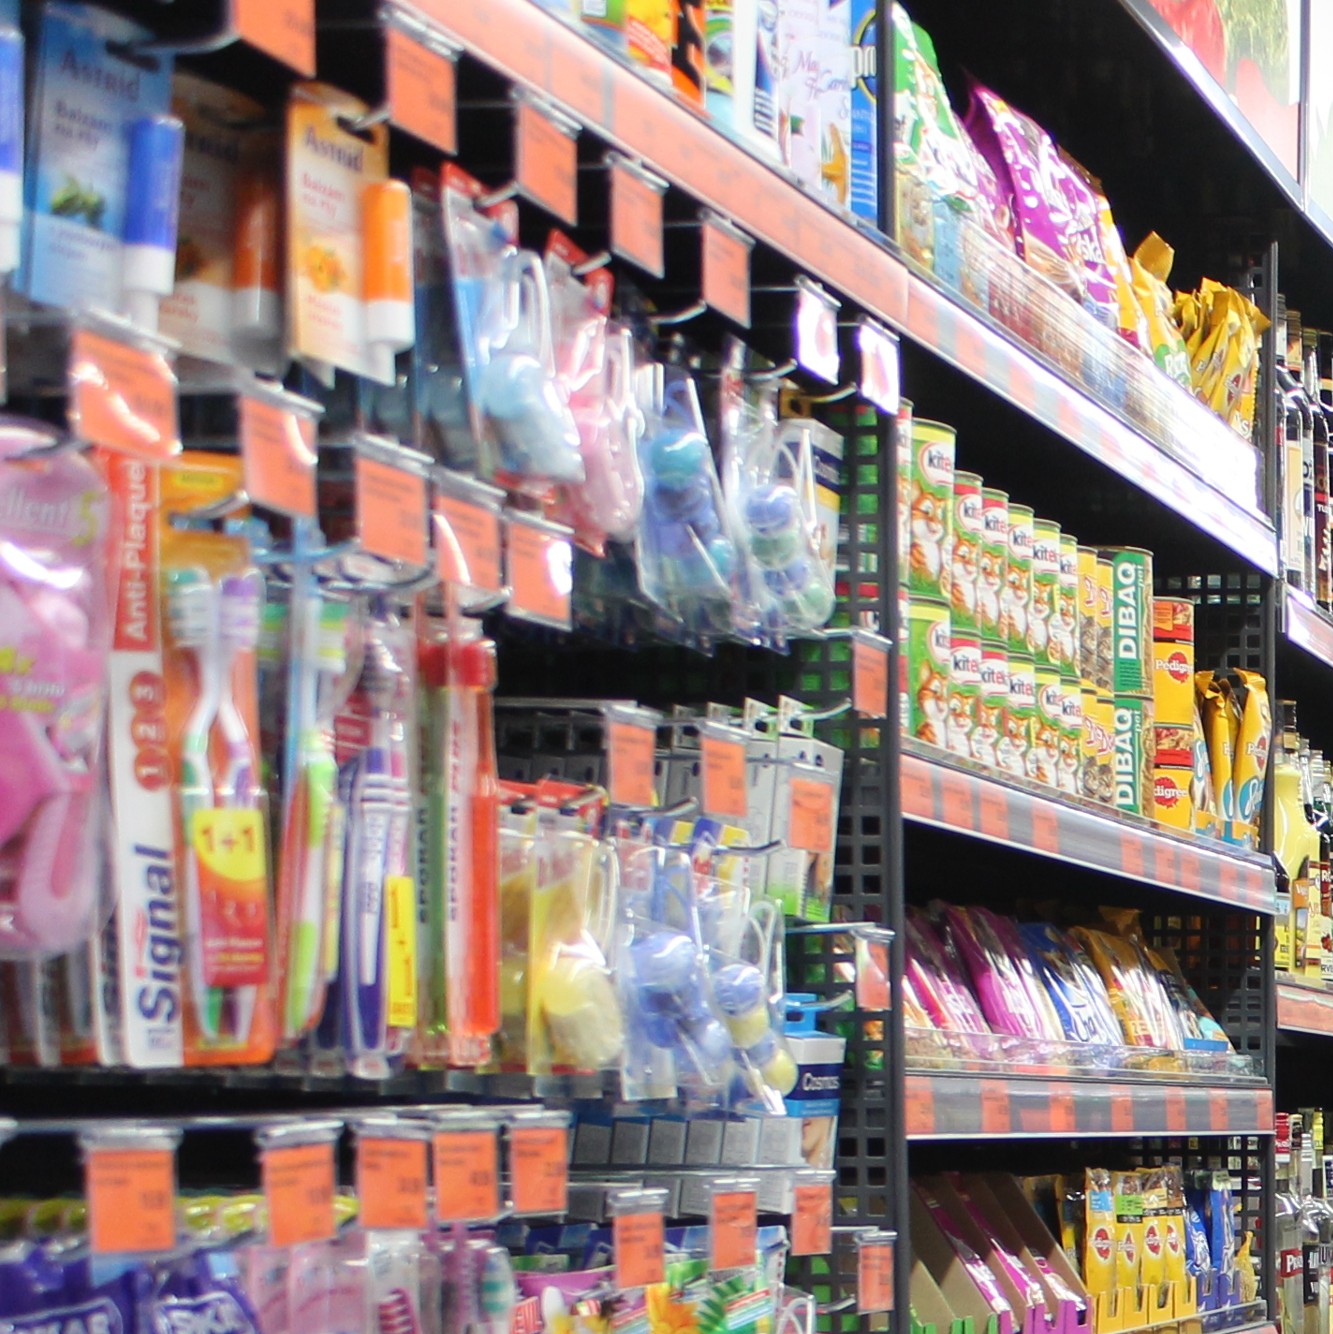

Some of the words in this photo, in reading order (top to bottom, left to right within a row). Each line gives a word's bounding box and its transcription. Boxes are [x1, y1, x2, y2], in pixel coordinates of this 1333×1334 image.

[125, 458, 154, 641] Anti-Plaque
[1118, 561, 1139, 660] DIBAQ
[1114, 707, 1135, 805] DIBAQ
[201, 824, 256, 854] 1+1
[134, 843, 182, 1023] Signal
